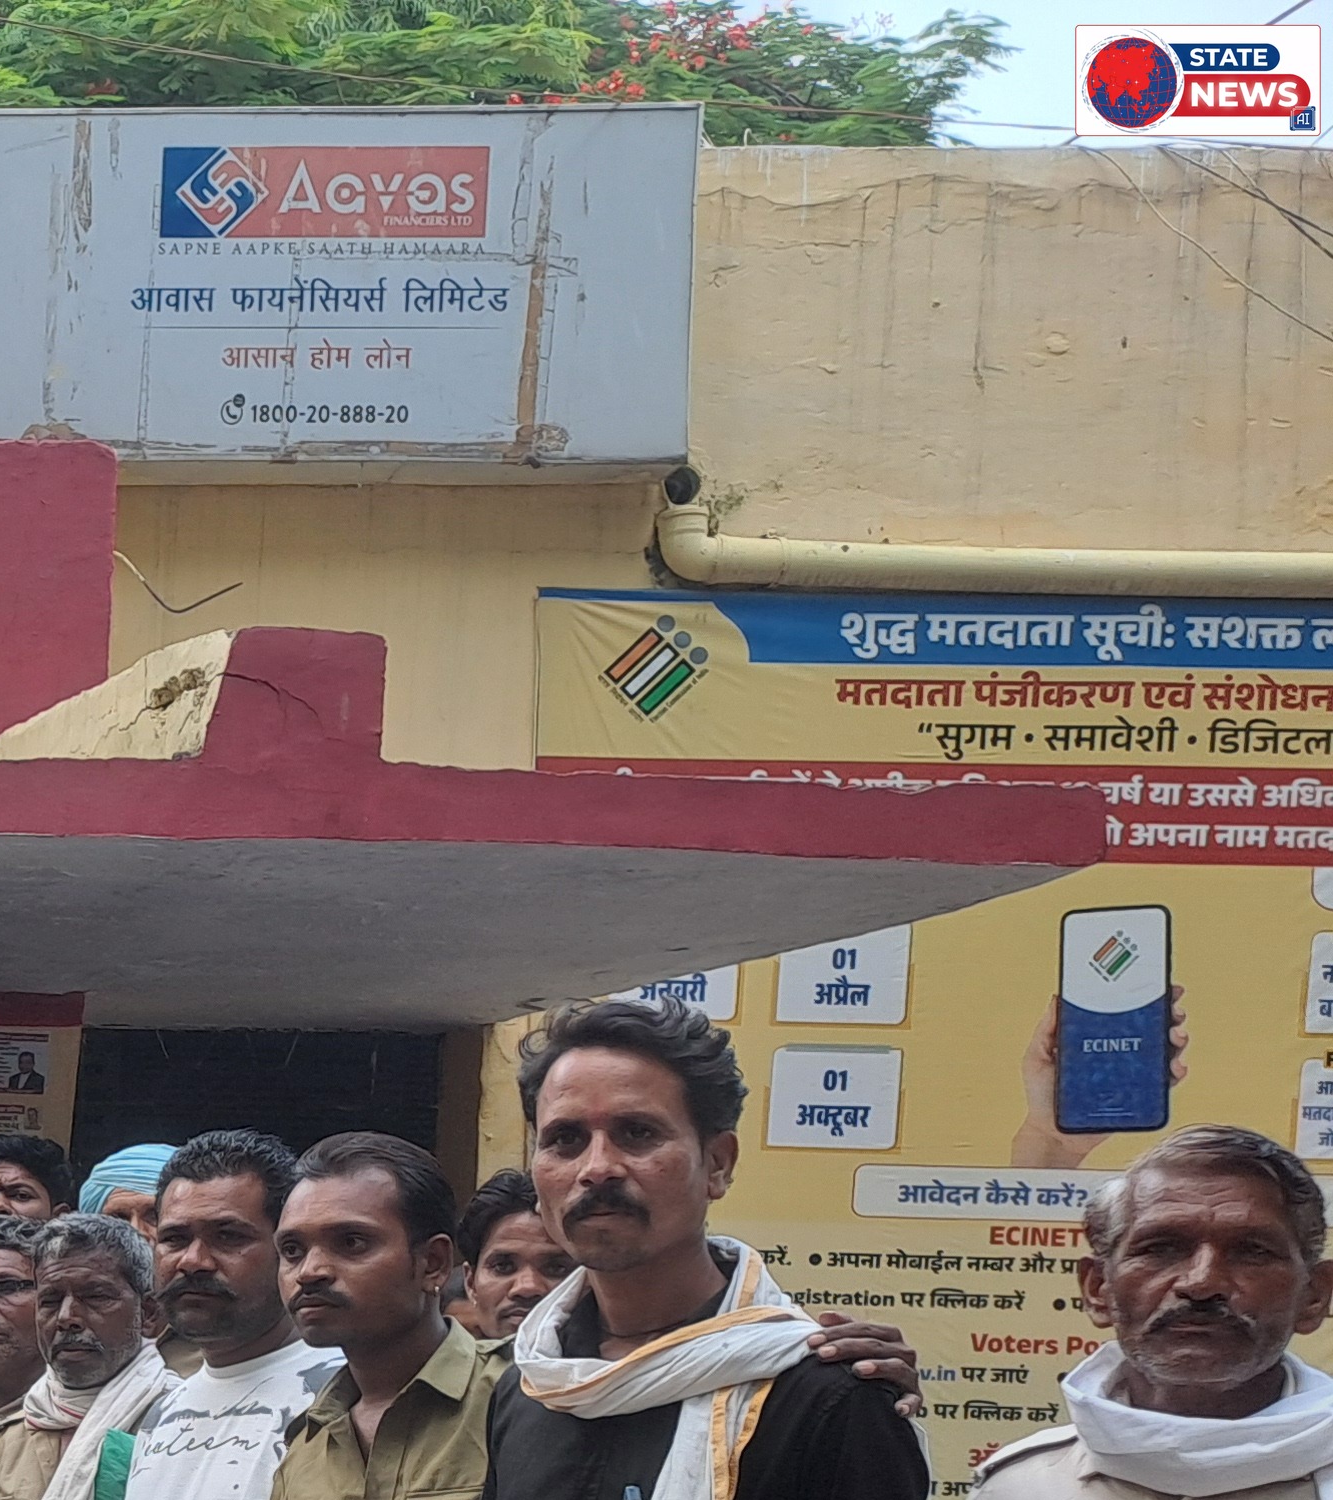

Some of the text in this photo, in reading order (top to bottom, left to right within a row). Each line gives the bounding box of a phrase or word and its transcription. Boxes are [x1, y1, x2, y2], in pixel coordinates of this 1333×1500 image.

[383, 215, 473, 227] FINANCIERS LTD
[158, 242, 485, 256] SAPNE AAPKE SAATH HAMAARA
[130, 277, 510, 313] आवास फायनेंसियर्स लिमिटेड
[221, 338, 412, 370] आसान होम लोन
[251, 404, 409, 425] 1800-20-888-20
[840, 612, 919, 658] शुद्ध
[926, 613, 1075, 647] मतदाता
[1082, 604, 1175, 661] सूची:
[1184, 616, 1304, 650] सशक्त
[835, 677, 965, 708] मतदाता
[973, 671, 1135, 710] पंजीकरण
[1142, 673, 1196, 711] एवं
[1044, 716, 1178, 753] समावेशी
[1208, 717, 1333, 755] डिजिटल
[1148, 783, 1183, 806] या
[1187, 776, 1256, 808] उससे
[1129, 824, 1210, 848] अपना
[1214, 825, 1269, 849] नाम
[832, 948, 856, 970] 01
[814, 975, 870, 1006] अप्रैल
[1083, 1038, 1142, 1053] ECINET
[823, 1069, 848, 1091] 01
[796, 1104, 871, 1136] अक्टूबर
[898, 1179, 1088, 1208] आवेदन कैसे करें?
[989, 1225, 1084, 1248] ECINET
[827, 1251, 882, 1269] अपना
[886, 1249, 963, 1272] मोबाईल
[967, 1255, 1015, 1272] नम्बर
[1019, 1251, 1056, 1273] और
[901, 1292, 924, 1308] पर
[930, 1287, 989, 1309] क्लिक
[993, 1290, 1026, 1310] करें
[971, 1333, 1058, 1354] Voters
[961, 1366, 987, 1382] पर
[990, 1364, 1029, 1383] जाएं
[934, 1404, 958, 1419] पर
[964, 1400, 1023, 1421] क्लिक
[1027, 1402, 1061, 1423] करें
